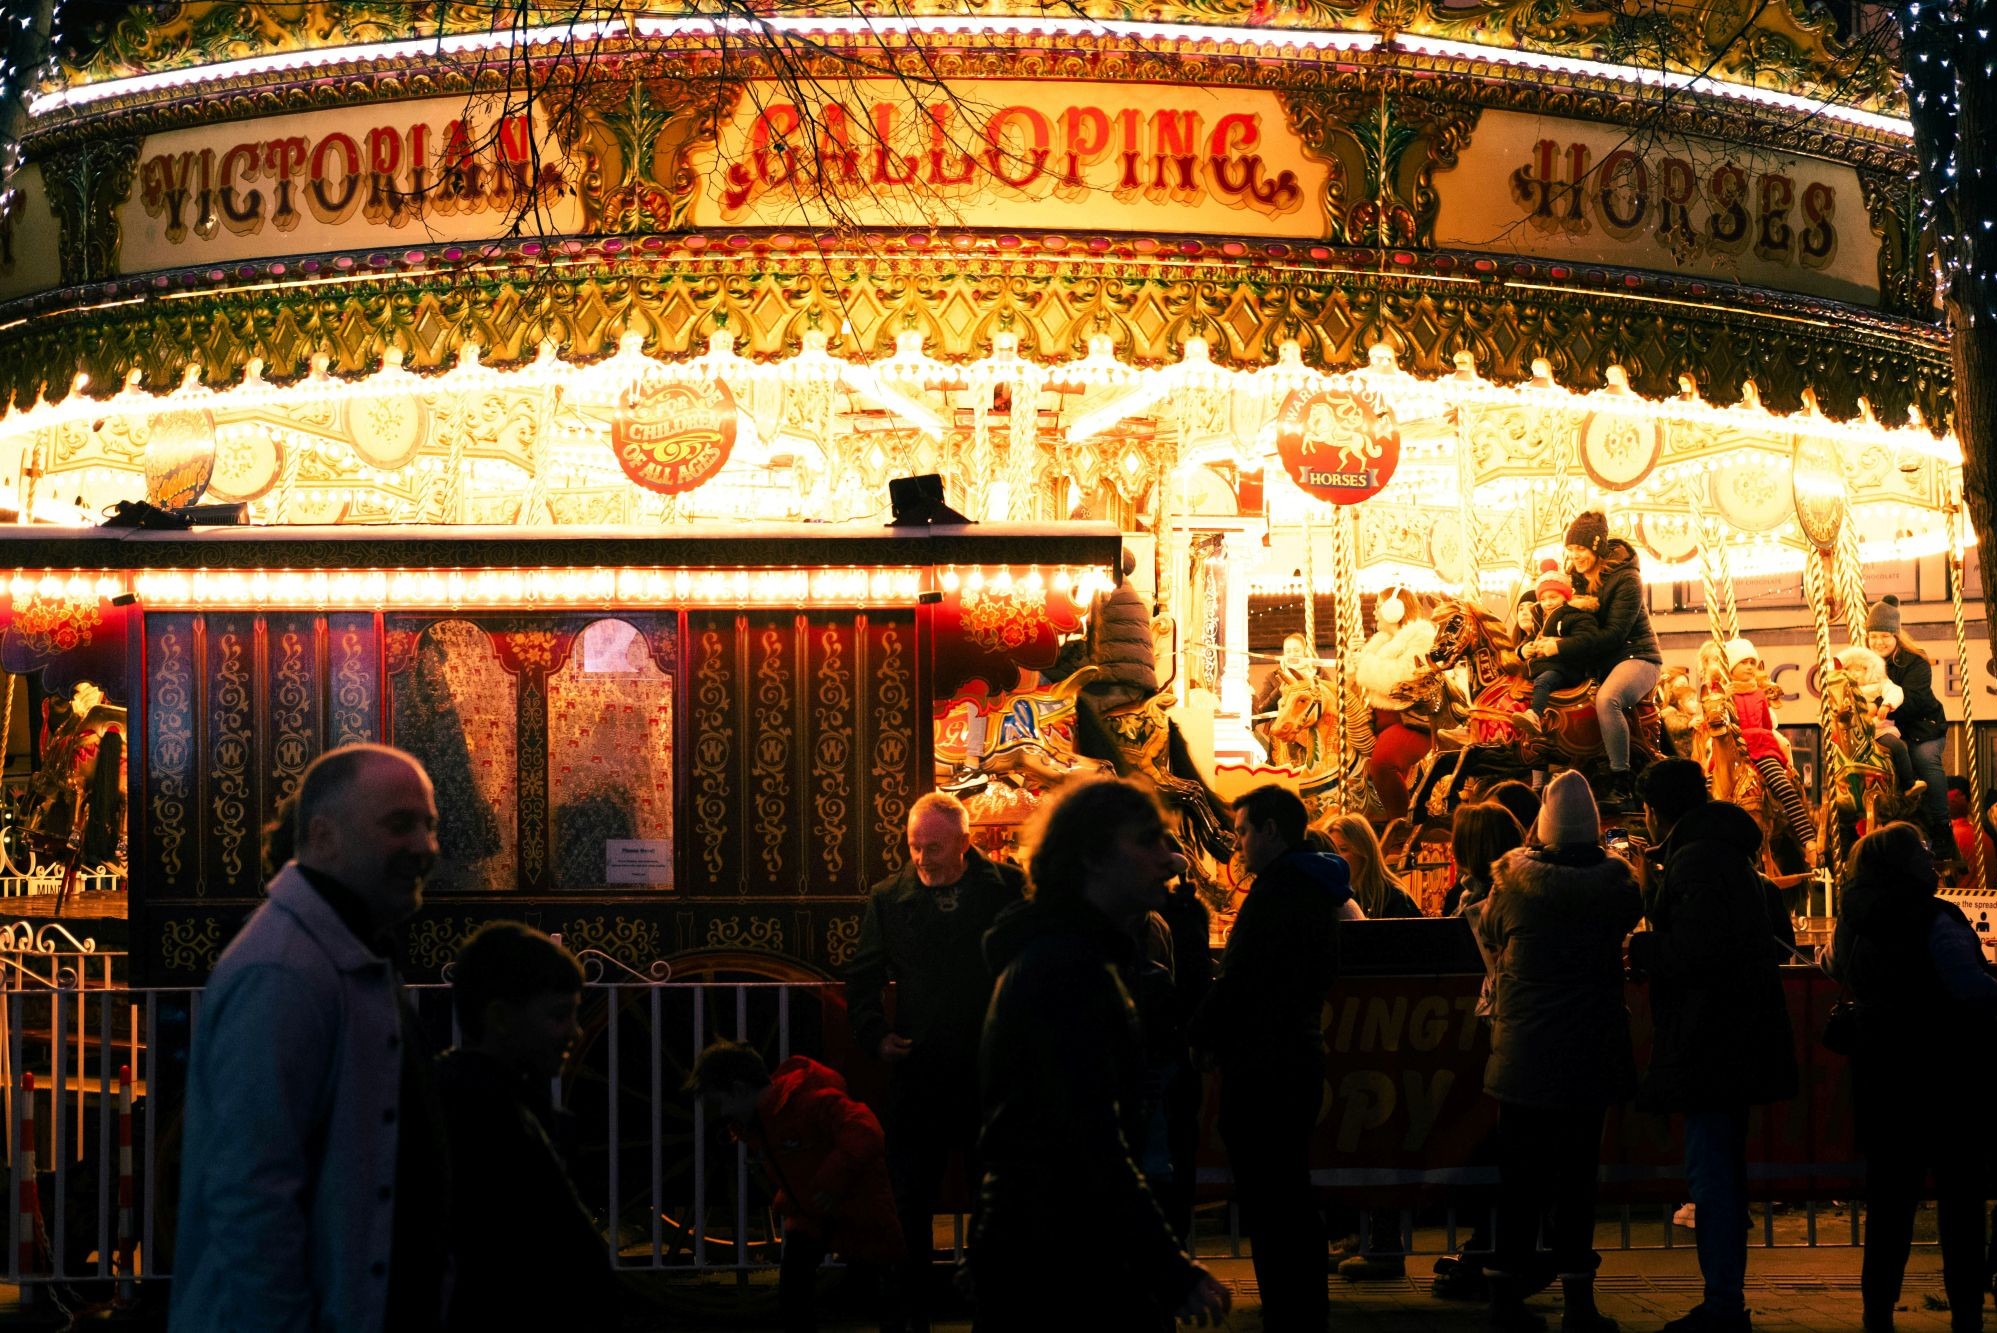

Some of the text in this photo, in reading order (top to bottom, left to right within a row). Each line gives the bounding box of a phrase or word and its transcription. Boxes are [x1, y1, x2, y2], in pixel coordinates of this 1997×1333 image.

[140, 114, 566, 242] VICTORIAN
[720, 99, 1304, 226] GALLOPING
[1510, 139, 1836, 266] HORSES
[629, 414, 721, 441] CHILDREN
[622, 442, 721, 485] OF ALL AGES
[1309, 472, 1367, 487] HORSES
[1962, 900, 1973, 908] the
